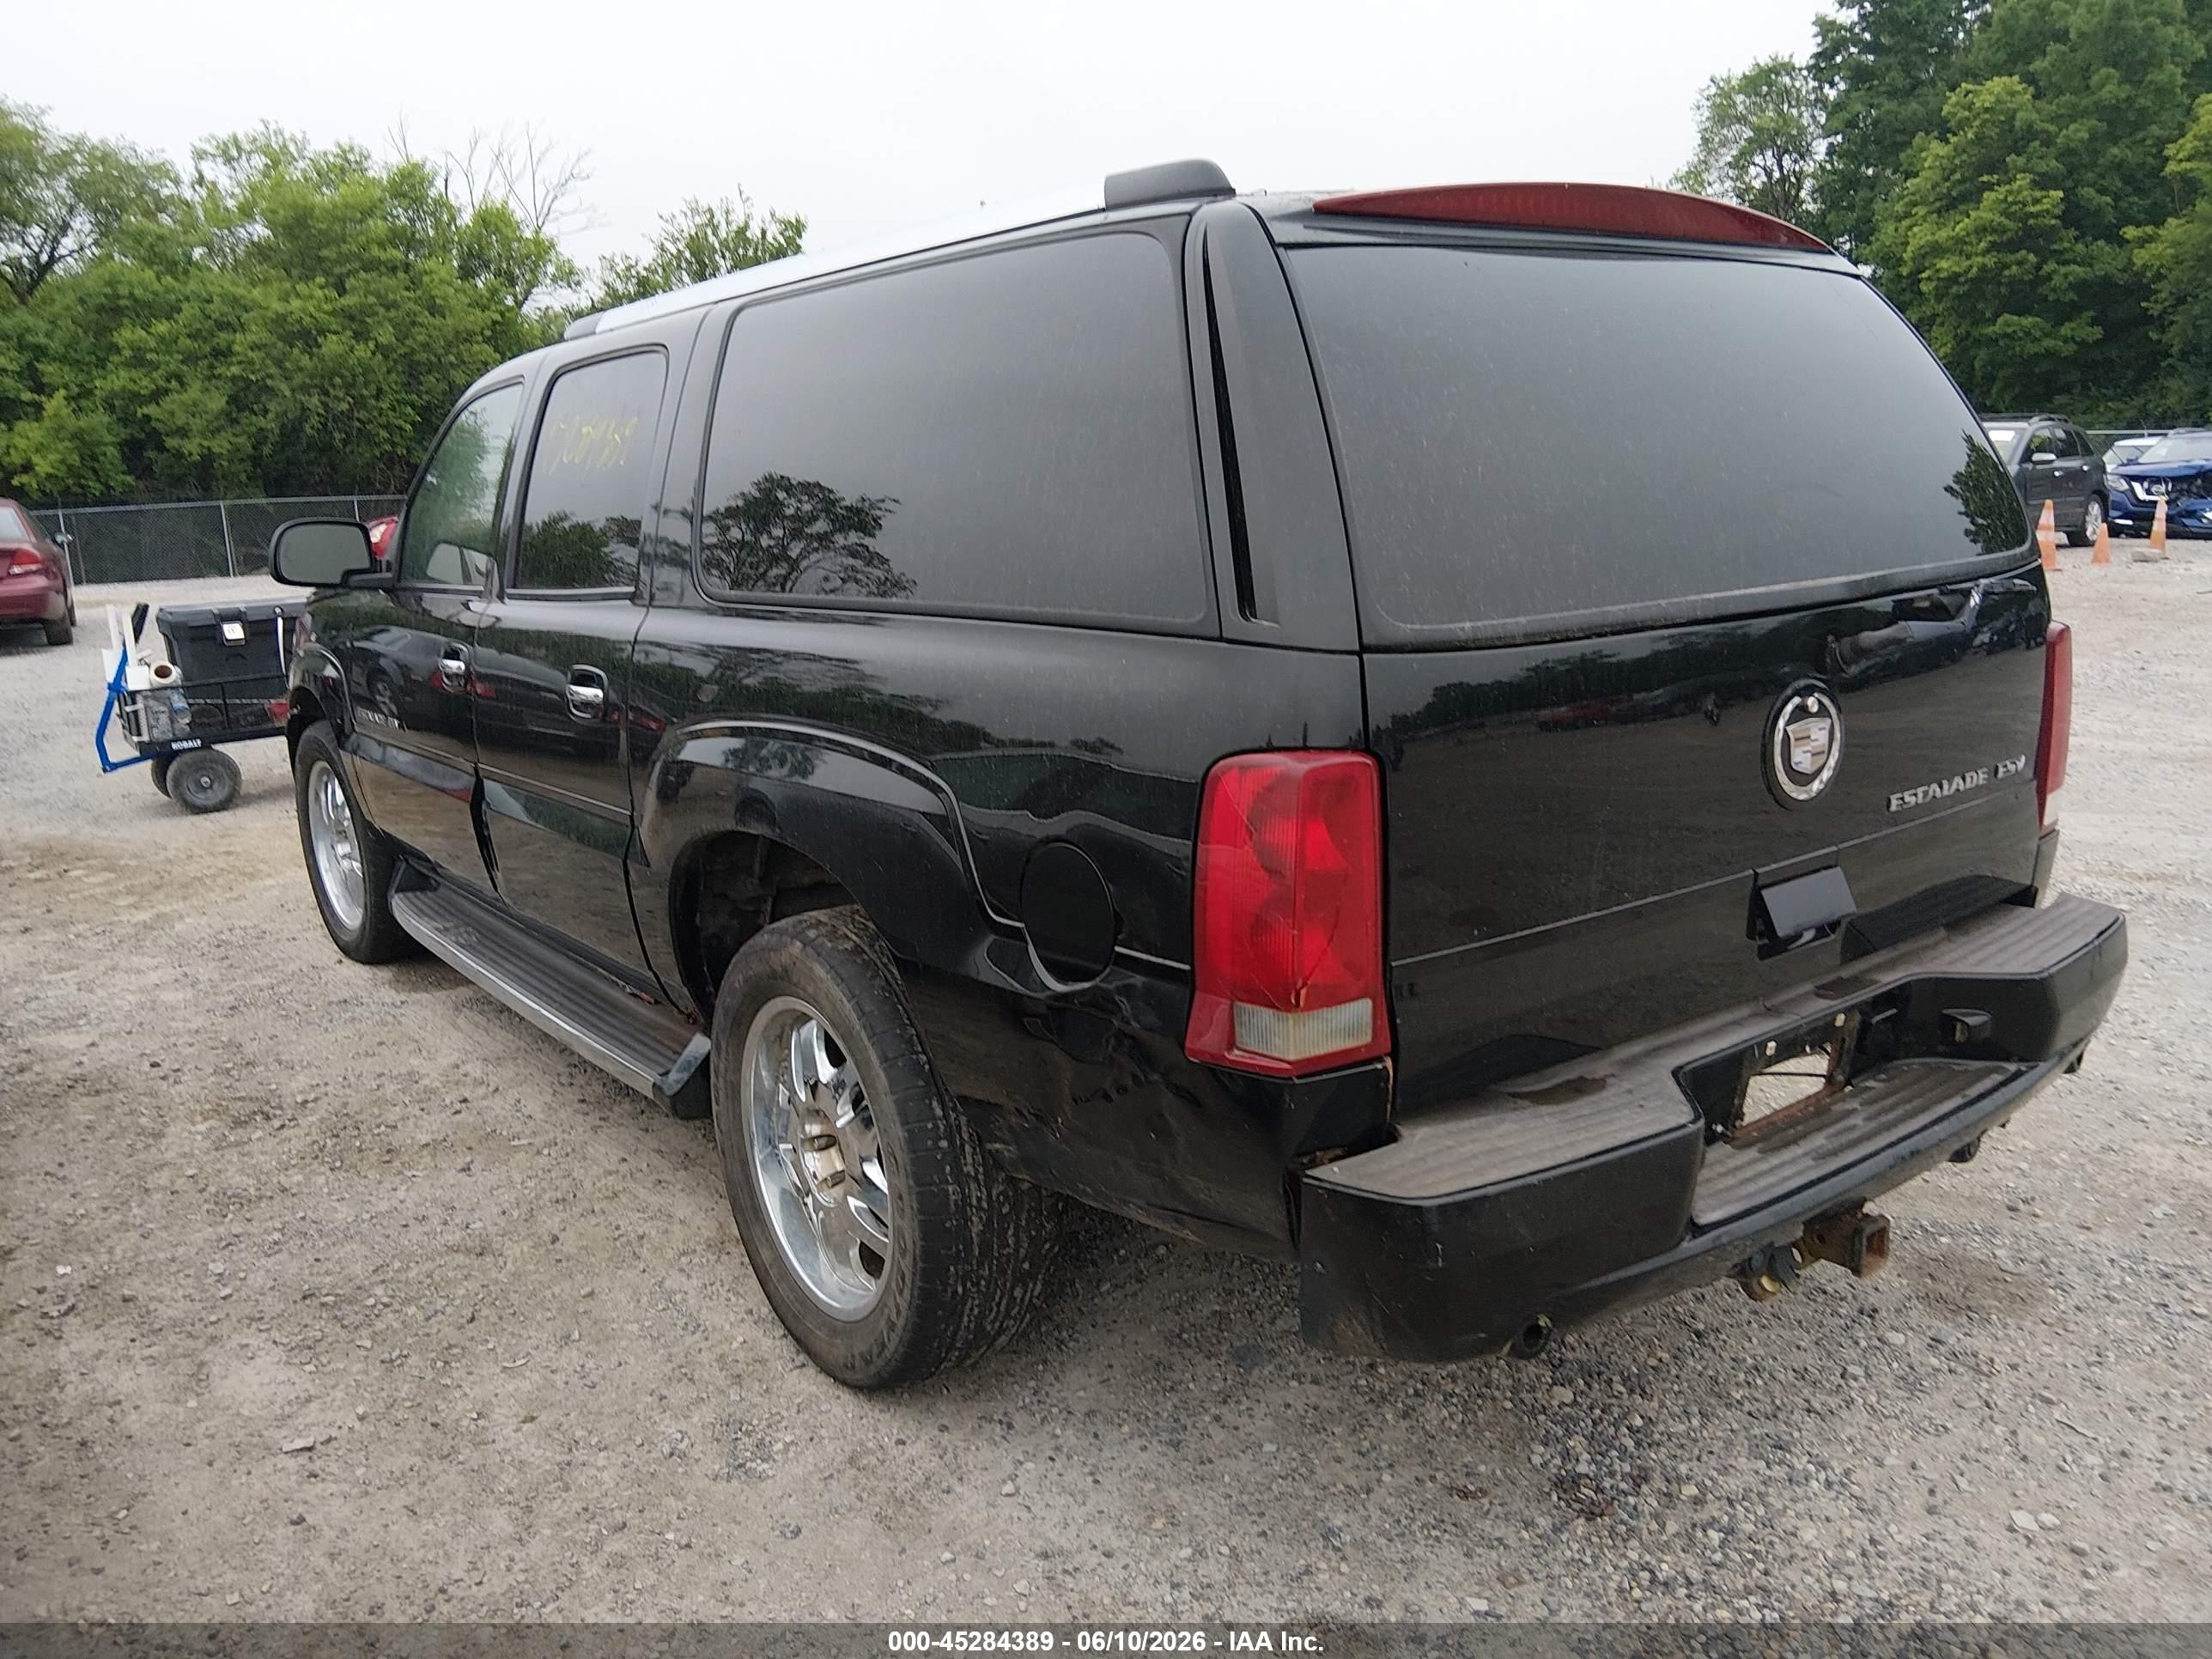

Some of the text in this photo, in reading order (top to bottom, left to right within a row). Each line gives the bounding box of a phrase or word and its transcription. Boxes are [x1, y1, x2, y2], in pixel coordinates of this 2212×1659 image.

[171, 738, 202, 750] KOBALT
[1888, 754, 2027, 812] ESCALADE ESV
